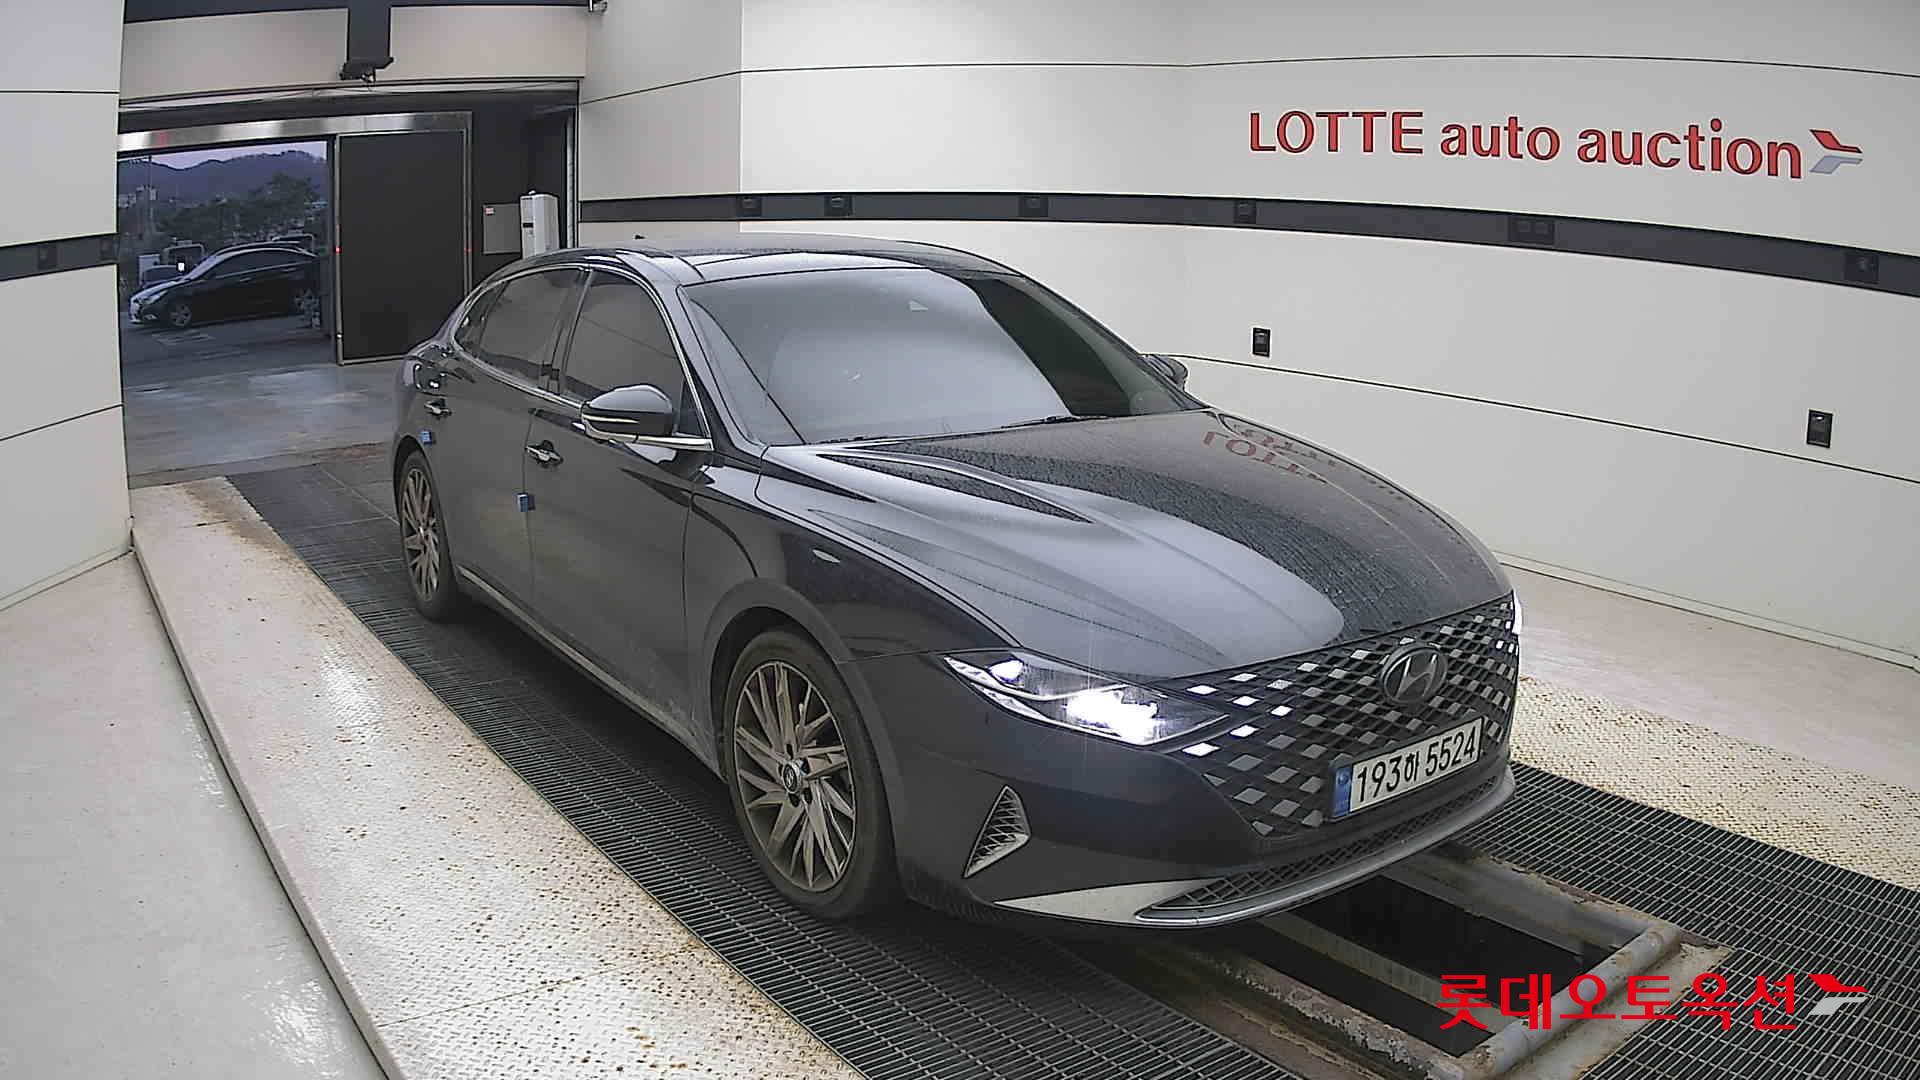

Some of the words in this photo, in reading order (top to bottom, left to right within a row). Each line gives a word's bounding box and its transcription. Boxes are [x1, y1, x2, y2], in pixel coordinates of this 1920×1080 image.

[1250, 110, 1424, 154] LOTTE
[1440, 116, 1561, 161] auto
[1577, 118, 1803, 180] auction
[1425, 725, 1477, 777] 5524
